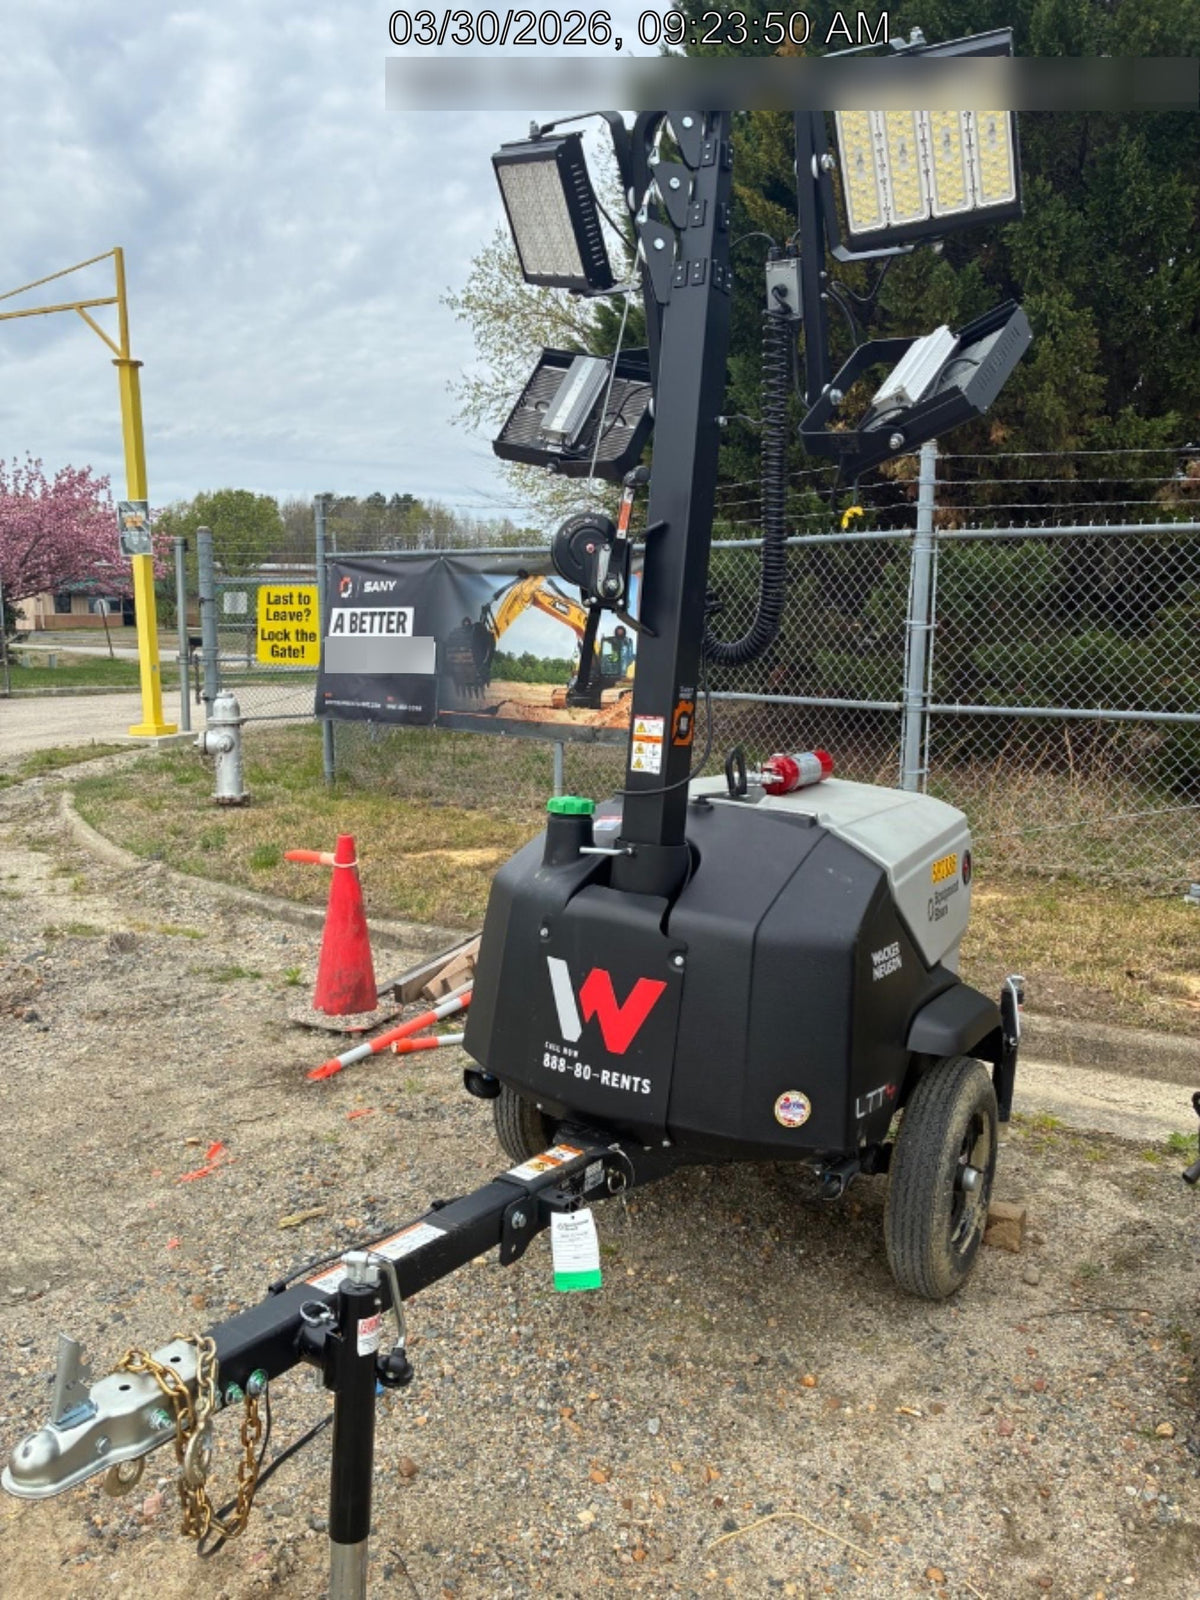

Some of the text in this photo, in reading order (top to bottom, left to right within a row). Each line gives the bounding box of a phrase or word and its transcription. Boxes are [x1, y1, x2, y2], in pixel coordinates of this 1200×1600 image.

[363, 580, 398, 593] SANY
[266, 591, 311, 606] Last to
[265, 607, 312, 623] Leave?
[332, 611, 408, 634] A BETTER
[260, 628, 318, 643] Lock the
[271, 643, 305, 659] Gate!
[543, 1052, 652, 1095] 888-80-RENTS
